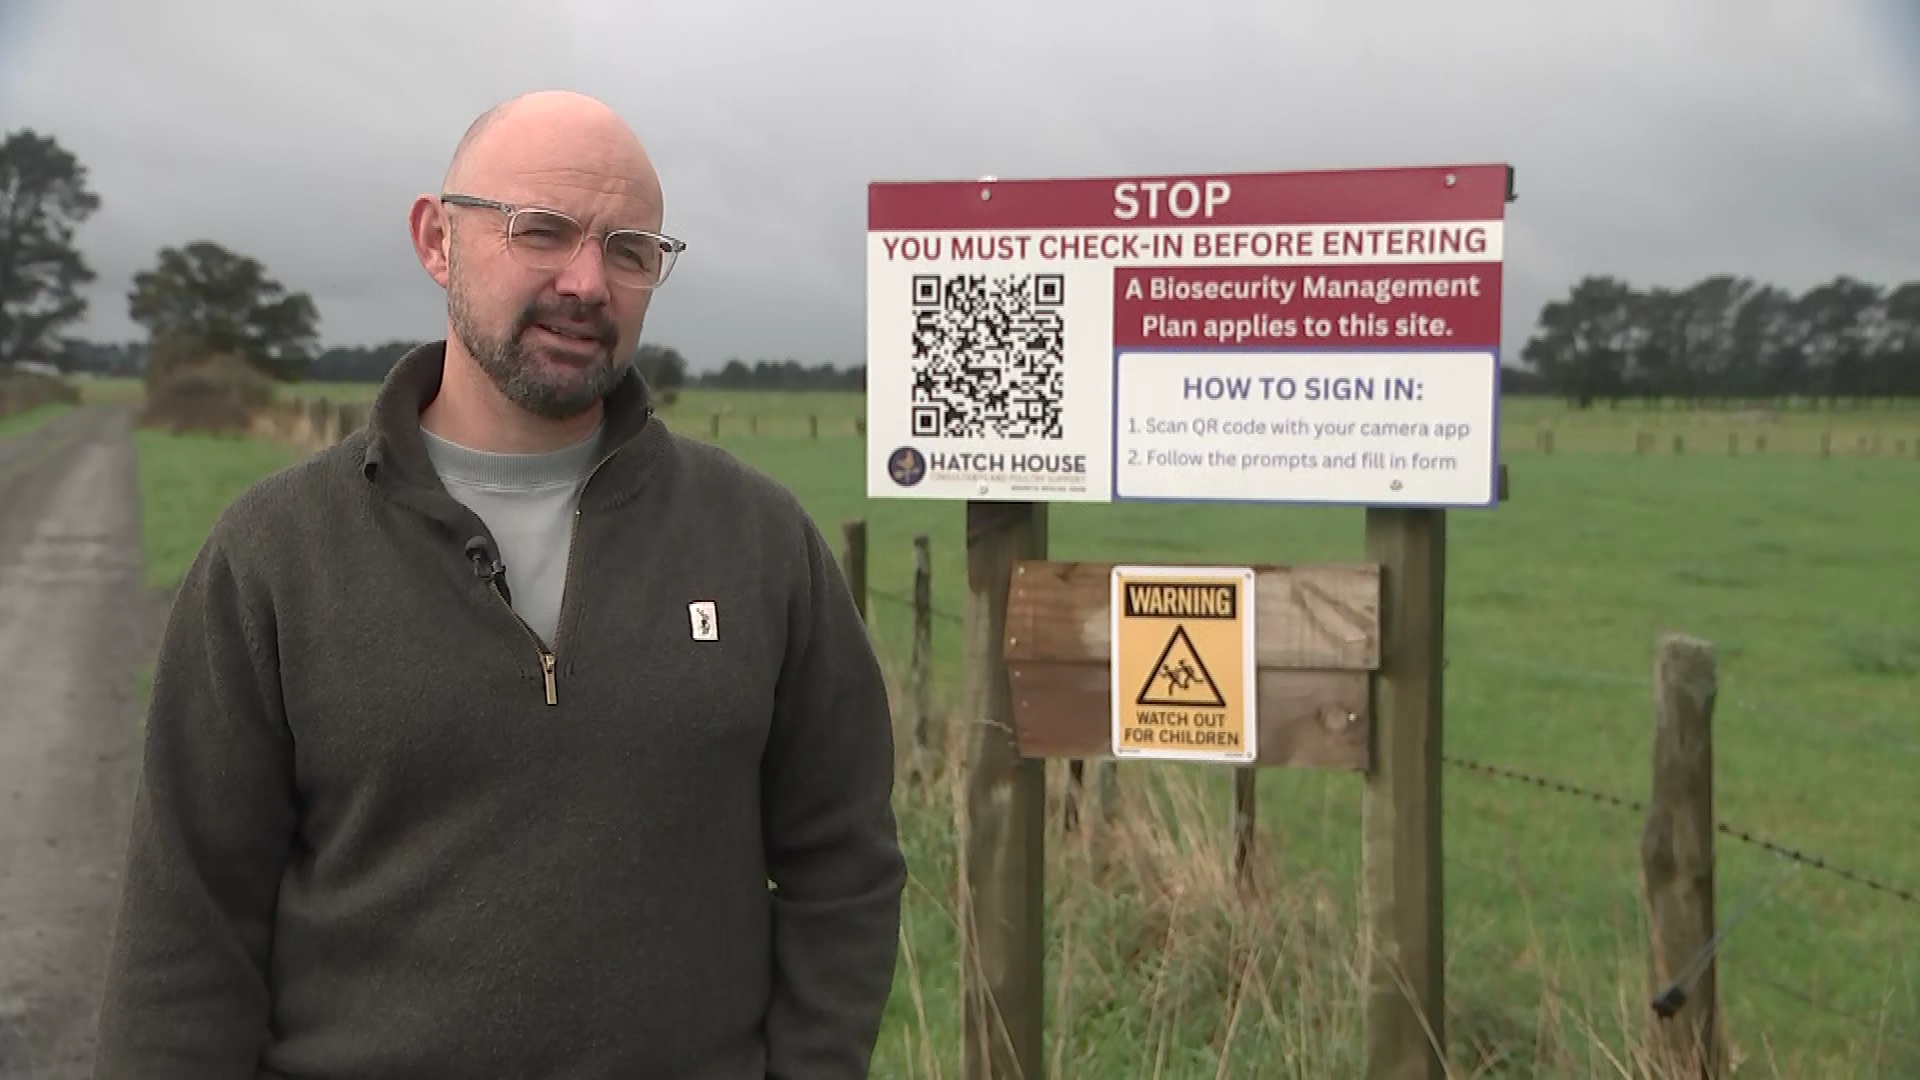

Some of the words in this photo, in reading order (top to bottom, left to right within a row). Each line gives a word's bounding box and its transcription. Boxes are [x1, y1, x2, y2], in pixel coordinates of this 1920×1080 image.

[1113, 180, 1231, 219] STOP
[882, 236, 941, 260] YOU
[951, 235, 1031, 260] MUST
[1039, 233, 1183, 260] CHECK-IN
[1193, 231, 1313, 258] BEFORE
[1323, 228, 1487, 256] ENTERING
[1125, 278, 1143, 300] A
[1150, 275, 1296, 304] Biosecurity
[1303, 275, 1480, 304] Management
[1142, 314, 1198, 338] Plan
[1203, 313, 1297, 342] applies
[1304, 317, 1332, 337] to
[1338, 313, 1388, 337] this
[1395, 312, 1453, 337] site.
[1183, 377, 1251, 401] HOW
[1258, 377, 1296, 401] TO
[1304, 377, 1374, 401] SIGN
[1384, 377, 1423, 401] IN:
[1128, 418, 1141, 434] 1.
[1146, 417, 1187, 435] Scan
[1192, 418, 1218, 436] QR
[1222, 417, 1266, 435] code
[1271, 417, 1309, 436] with
[1314, 422, 1355, 440] your
[1361, 422, 1429, 438] camera
[1434, 423, 1471, 441] app
[931, 452, 1004, 471] HATCH
[1012, 455, 1086, 473] HOUSE
[1128, 450, 1142, 467] 2.
[1147, 450, 1203, 468] Follow
[1207, 451, 1236, 468] the
[1241, 453, 1317, 471] prompts
[1322, 452, 1357, 470] and
[1361, 452, 1386, 470] fill
[1390, 453, 1406, 469] in
[1411, 453, 1456, 470] form
[1128, 585, 1231, 615] WARNING
[1137, 711, 1188, 726] WATCH
[1194, 713, 1226, 727] OUT
[1124, 728, 1154, 742] FOR
[1159, 730, 1239, 746] CHILDREN
